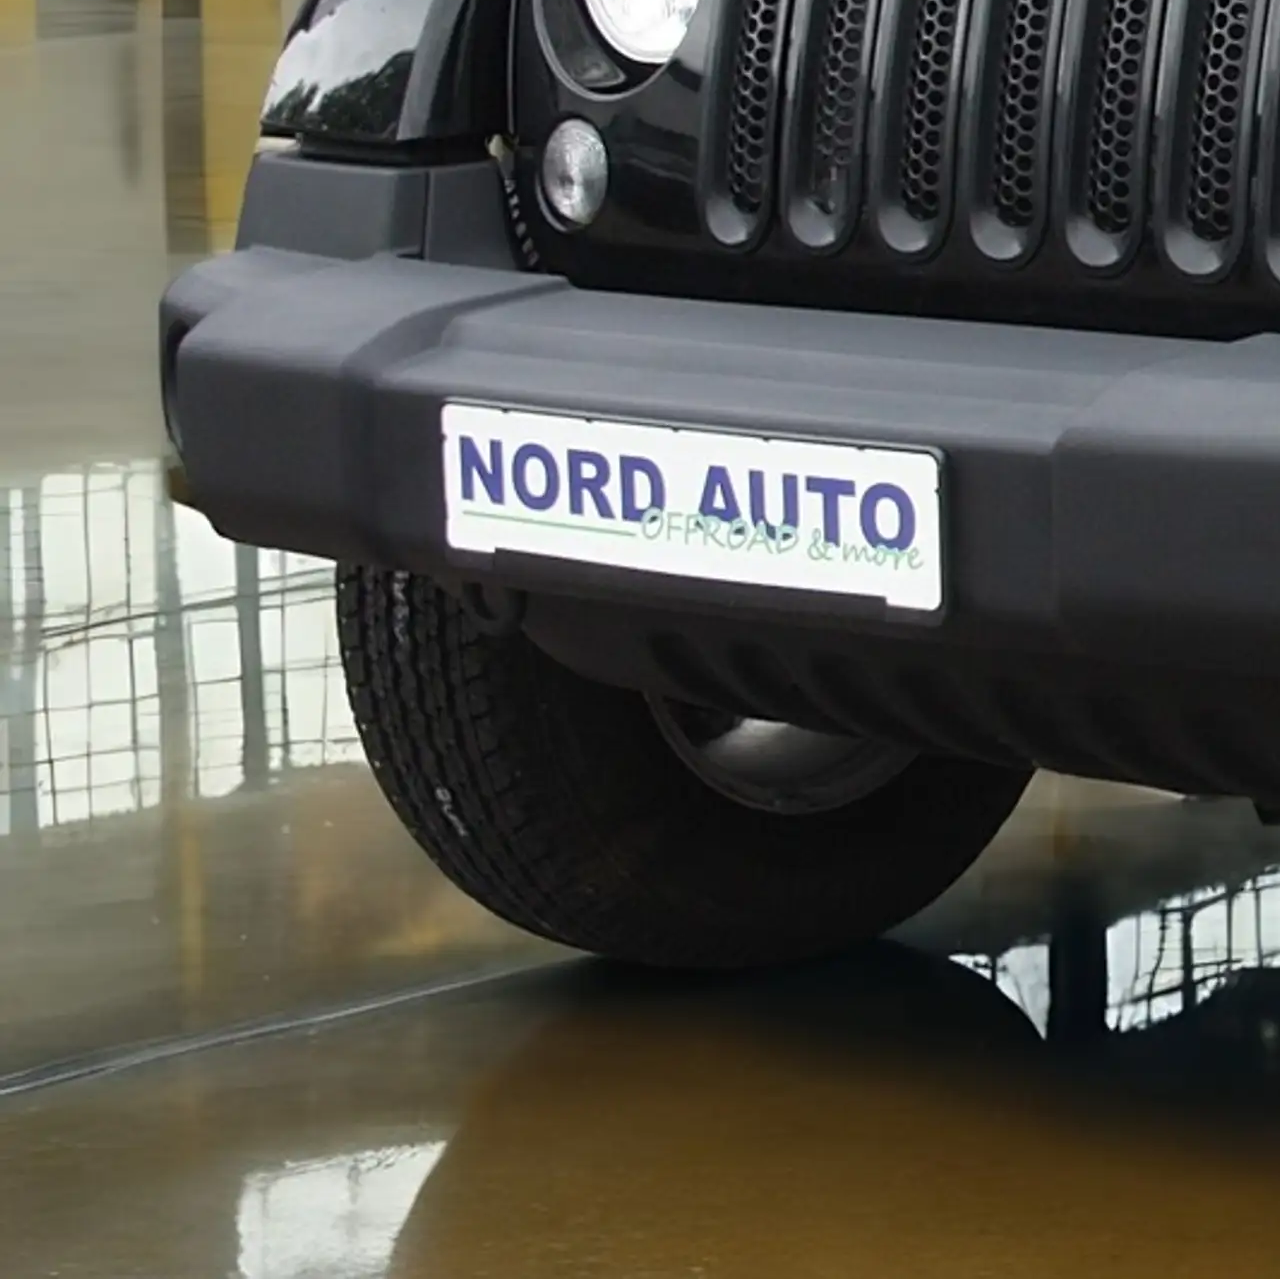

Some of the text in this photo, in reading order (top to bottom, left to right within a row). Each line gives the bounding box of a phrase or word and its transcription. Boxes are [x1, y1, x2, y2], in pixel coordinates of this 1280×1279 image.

[459, 435, 917, 552] NORD AUTO
[641, 507, 925, 571] OFFROAD & more
